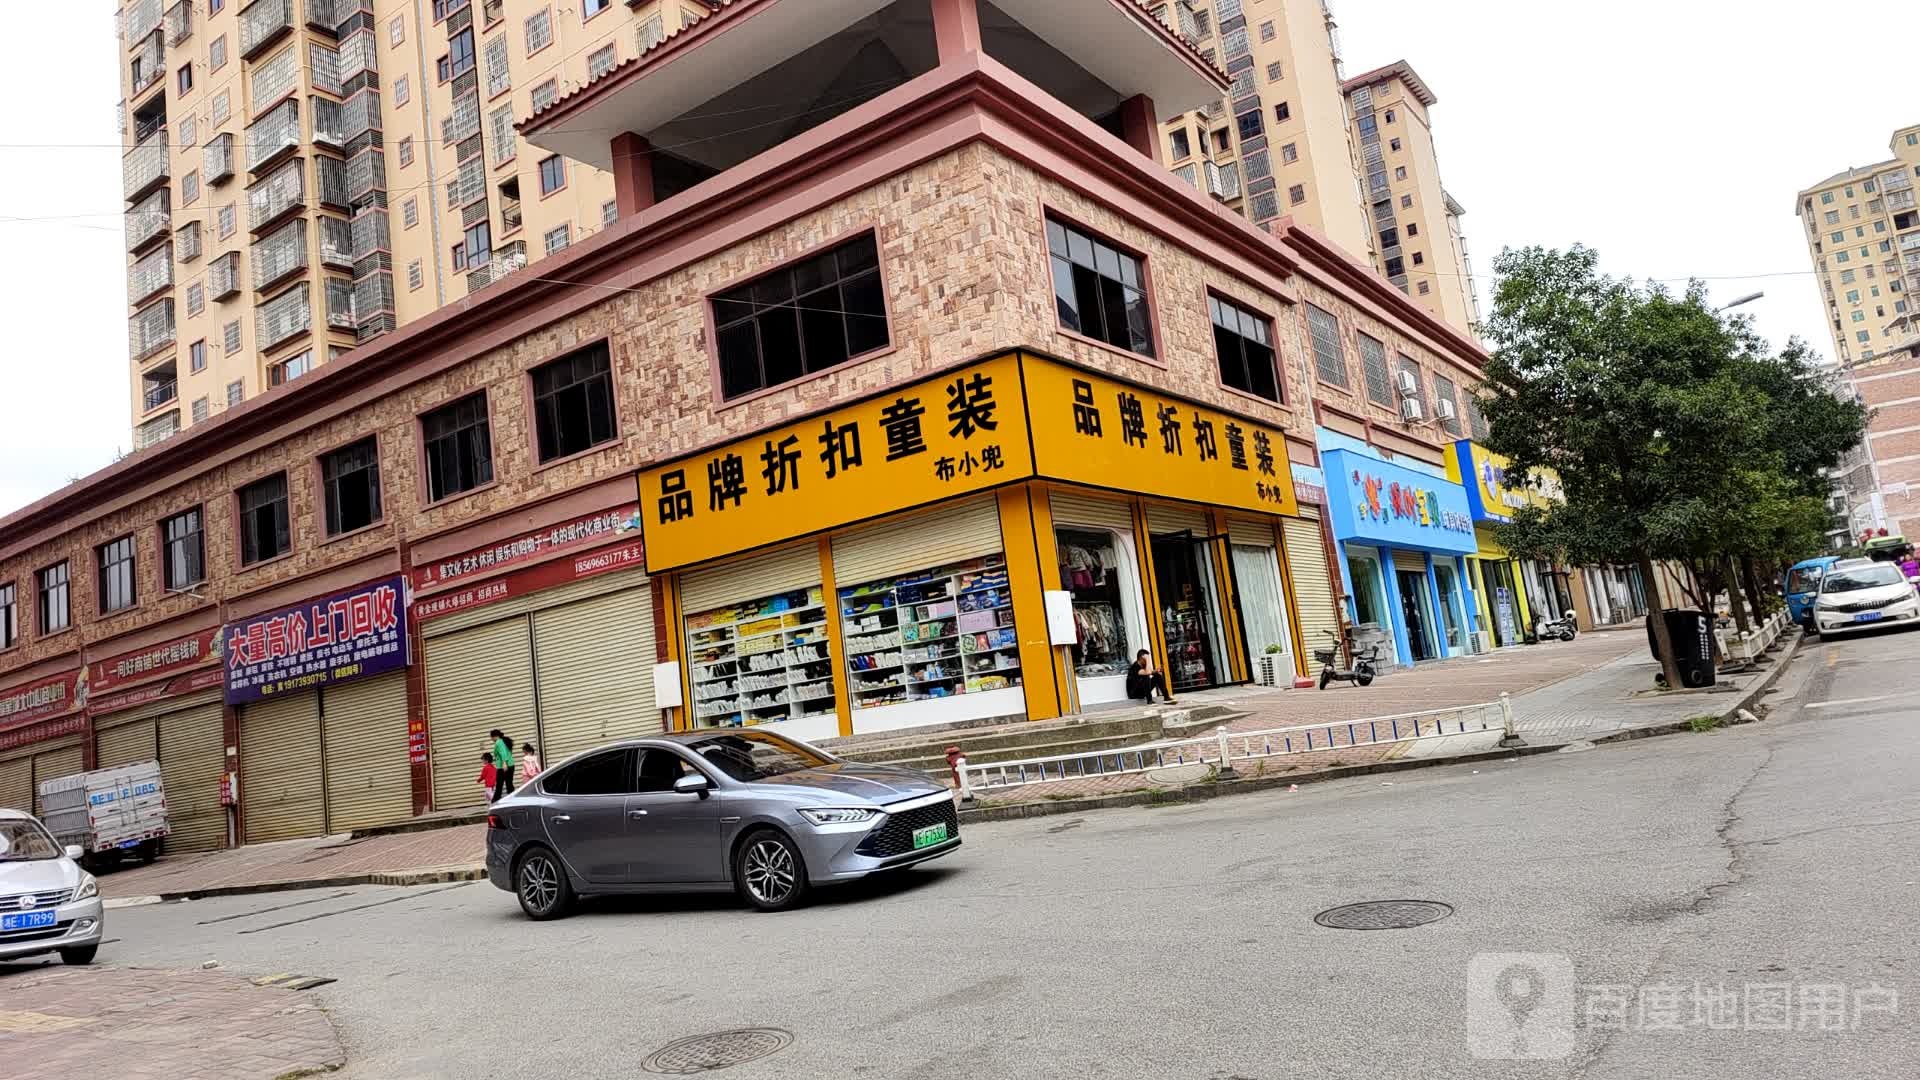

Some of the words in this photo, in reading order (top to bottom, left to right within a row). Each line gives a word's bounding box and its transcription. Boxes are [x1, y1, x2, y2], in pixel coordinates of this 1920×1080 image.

[658, 372, 998, 524] 品牌折扣童装
[1071, 378, 1276, 477] 品牌折扣童装
[934, 444, 1005, 483] 布小兜
[1257, 479, 1282, 505] 布小兜
[229, 586, 398, 669] 大量高价上门回收
[1698, 616, 1707, 633] 5
